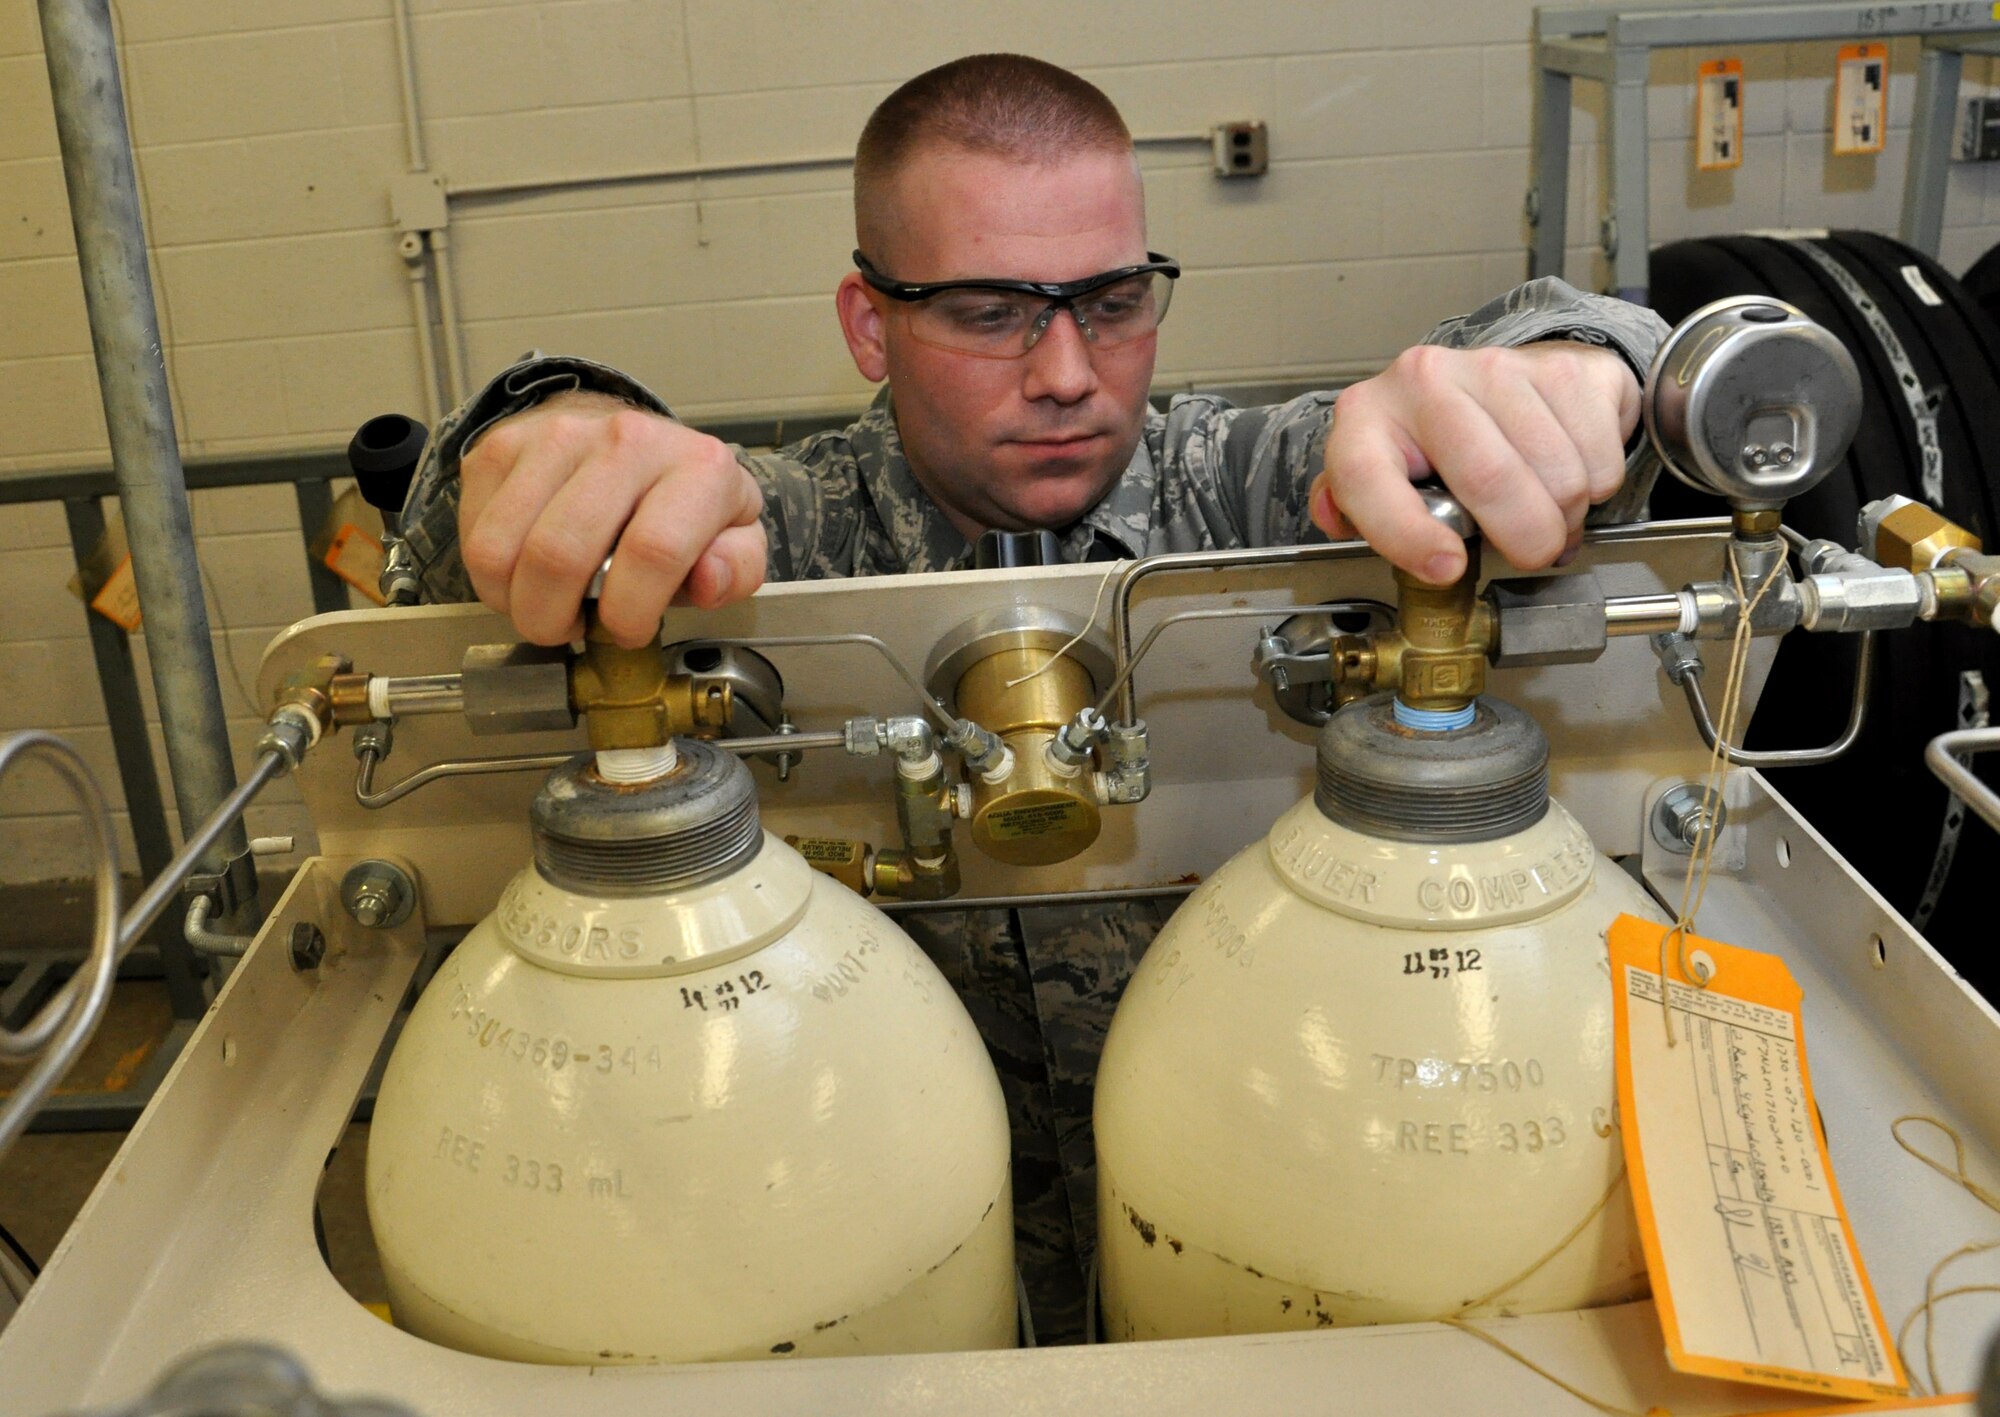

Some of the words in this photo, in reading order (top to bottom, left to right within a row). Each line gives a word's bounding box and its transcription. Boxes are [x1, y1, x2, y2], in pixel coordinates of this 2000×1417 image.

[1456, 949, 1482, 972] 12
[740, 970, 771, 994] 12
[1499, 1116, 1567, 1152] 333
[503, 1154, 563, 1192] 333
